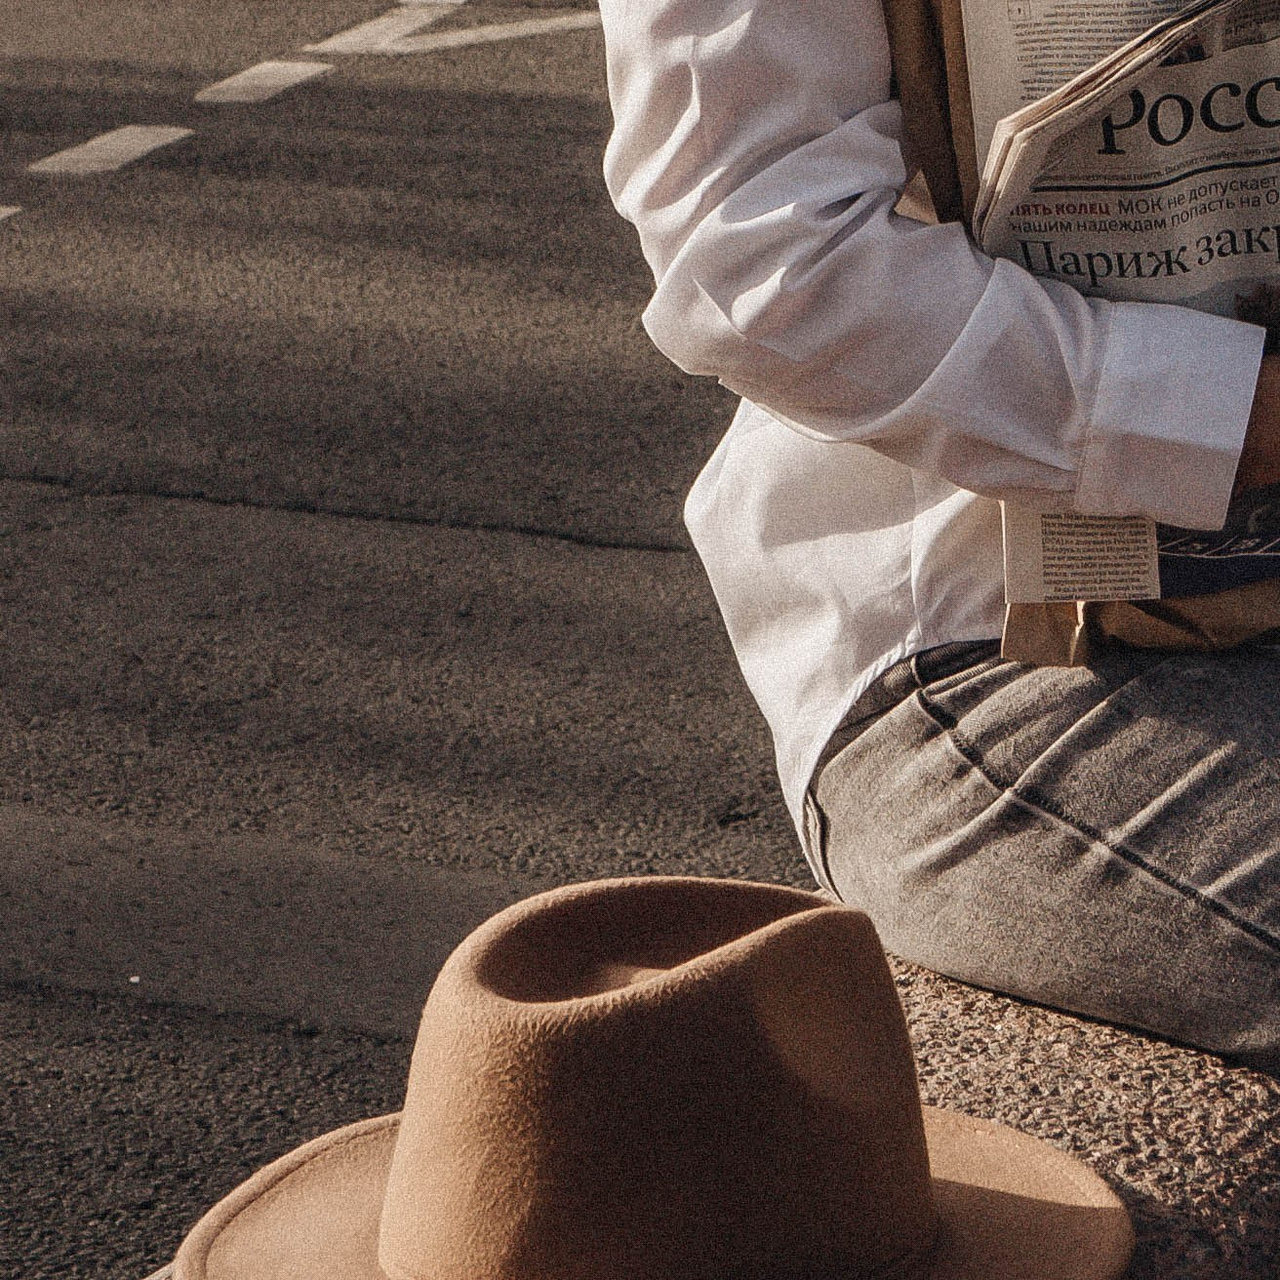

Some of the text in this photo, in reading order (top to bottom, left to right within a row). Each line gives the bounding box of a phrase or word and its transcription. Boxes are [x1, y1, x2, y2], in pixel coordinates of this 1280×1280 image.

[1055, 202, 1111, 217] КОЛЕЦ
[1117, 195, 1164, 216] МОК
[1167, 194, 1186, 210] не
[1189, 175, 1278, 207] допускает
[1076, 217, 1167, 235] надеждам
[1170, 197, 1236, 227] попасть
[1240, 195, 1261, 208] на
[1017, 239, 1190, 288] Париж
